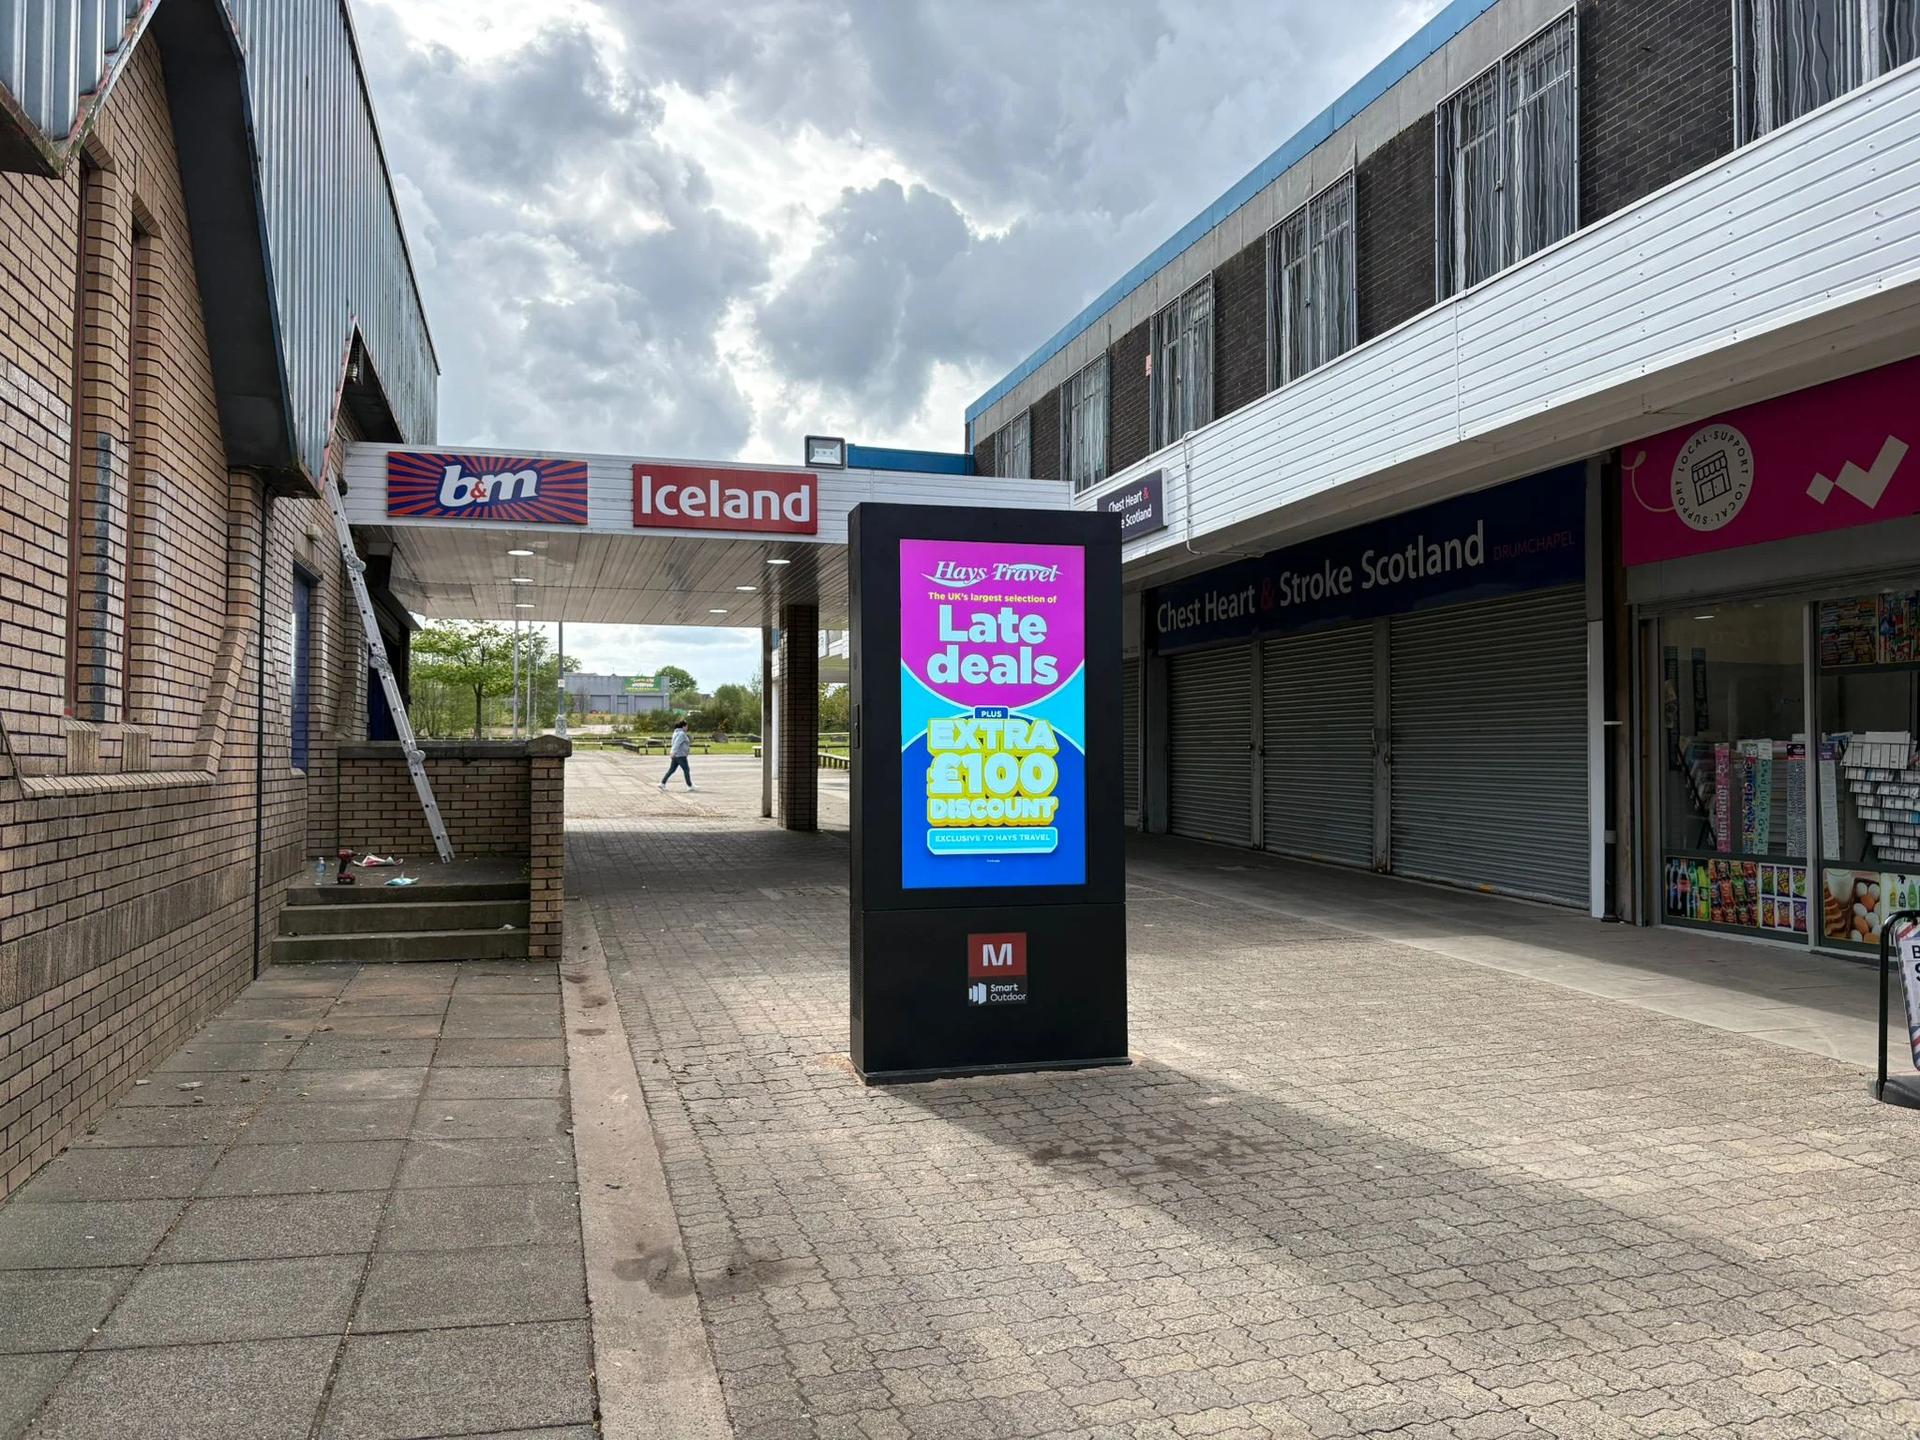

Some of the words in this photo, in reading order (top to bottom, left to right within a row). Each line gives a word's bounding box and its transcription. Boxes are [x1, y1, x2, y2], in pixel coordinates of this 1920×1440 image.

[439, 464, 539, 508] b&m
[641, 475, 811, 522] Iceland
[1108, 497, 1125, 512] Chest
[1125, 490, 1143, 508] Heart
[1125, 503, 1152, 527] Scotland
[933, 561, 988, 584] Hays
[992, 562, 1059, 582] Travel
[1157, 600, 1201, 633] Chest
[1205, 585, 1256, 624] Heart
[1261, 577, 1275, 612] &
[1280, 558, 1353, 607] Stroke
[1361, 519, 1485, 590] Scotland
[1492, 528, 1576, 561] DRUMCHAPEL
[928, 592, 946, 601] The
[948, 592, 968, 601] UK's
[970, 593, 1002, 604] largest
[1004, 594, 1045, 604] selection
[1047, 595, 1057, 604] of
[939, 604, 1048, 644] Late
[926, 644, 1059, 685] deals
[981, 710, 1002, 718] PLUS
[929, 718, 1058, 752] EXTRA
[928, 751, 1058, 795] £100
[929, 797, 1057, 821] DISCOUNT
[982, 834, 994, 842] TO
[1020, 833, 1050, 841] TRAVEL
[982, 943, 1013, 967] M
[990, 983, 1019, 992] Smart
[990, 993, 1027, 1001] Outdoor
